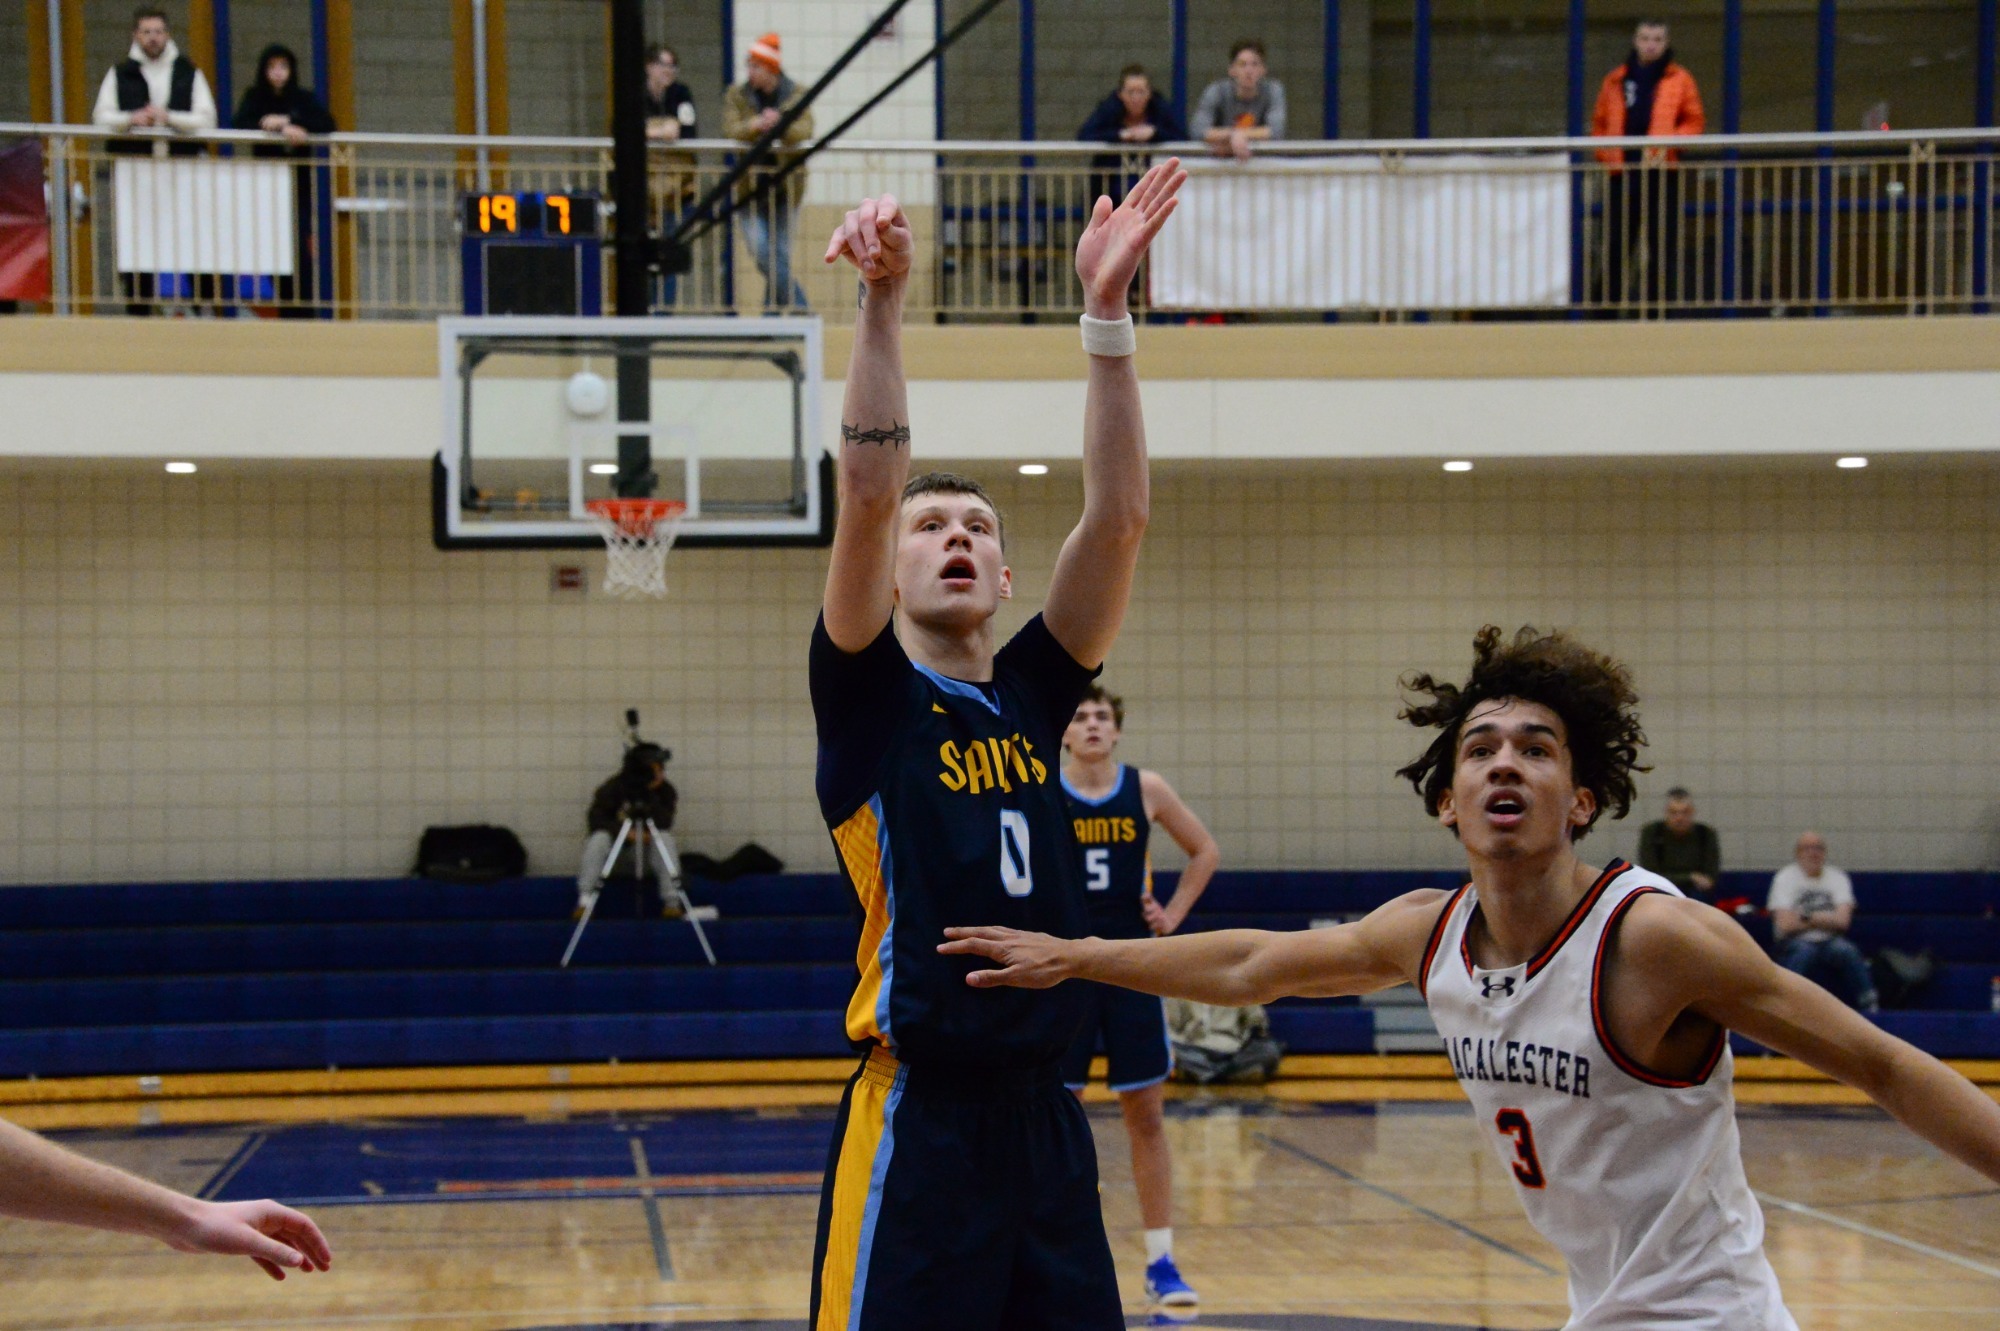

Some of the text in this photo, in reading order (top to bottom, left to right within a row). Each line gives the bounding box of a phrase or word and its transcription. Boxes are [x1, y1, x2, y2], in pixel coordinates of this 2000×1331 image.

[479, 195, 570, 234] 19 7
[1000, 808, 1034, 897] 0
[1073, 816, 1137, 844] AINTS
[1086, 848, 1110, 891] 5
[1443, 1036, 1591, 1098] ACALESTER
[1495, 1107, 1546, 1189] 3
